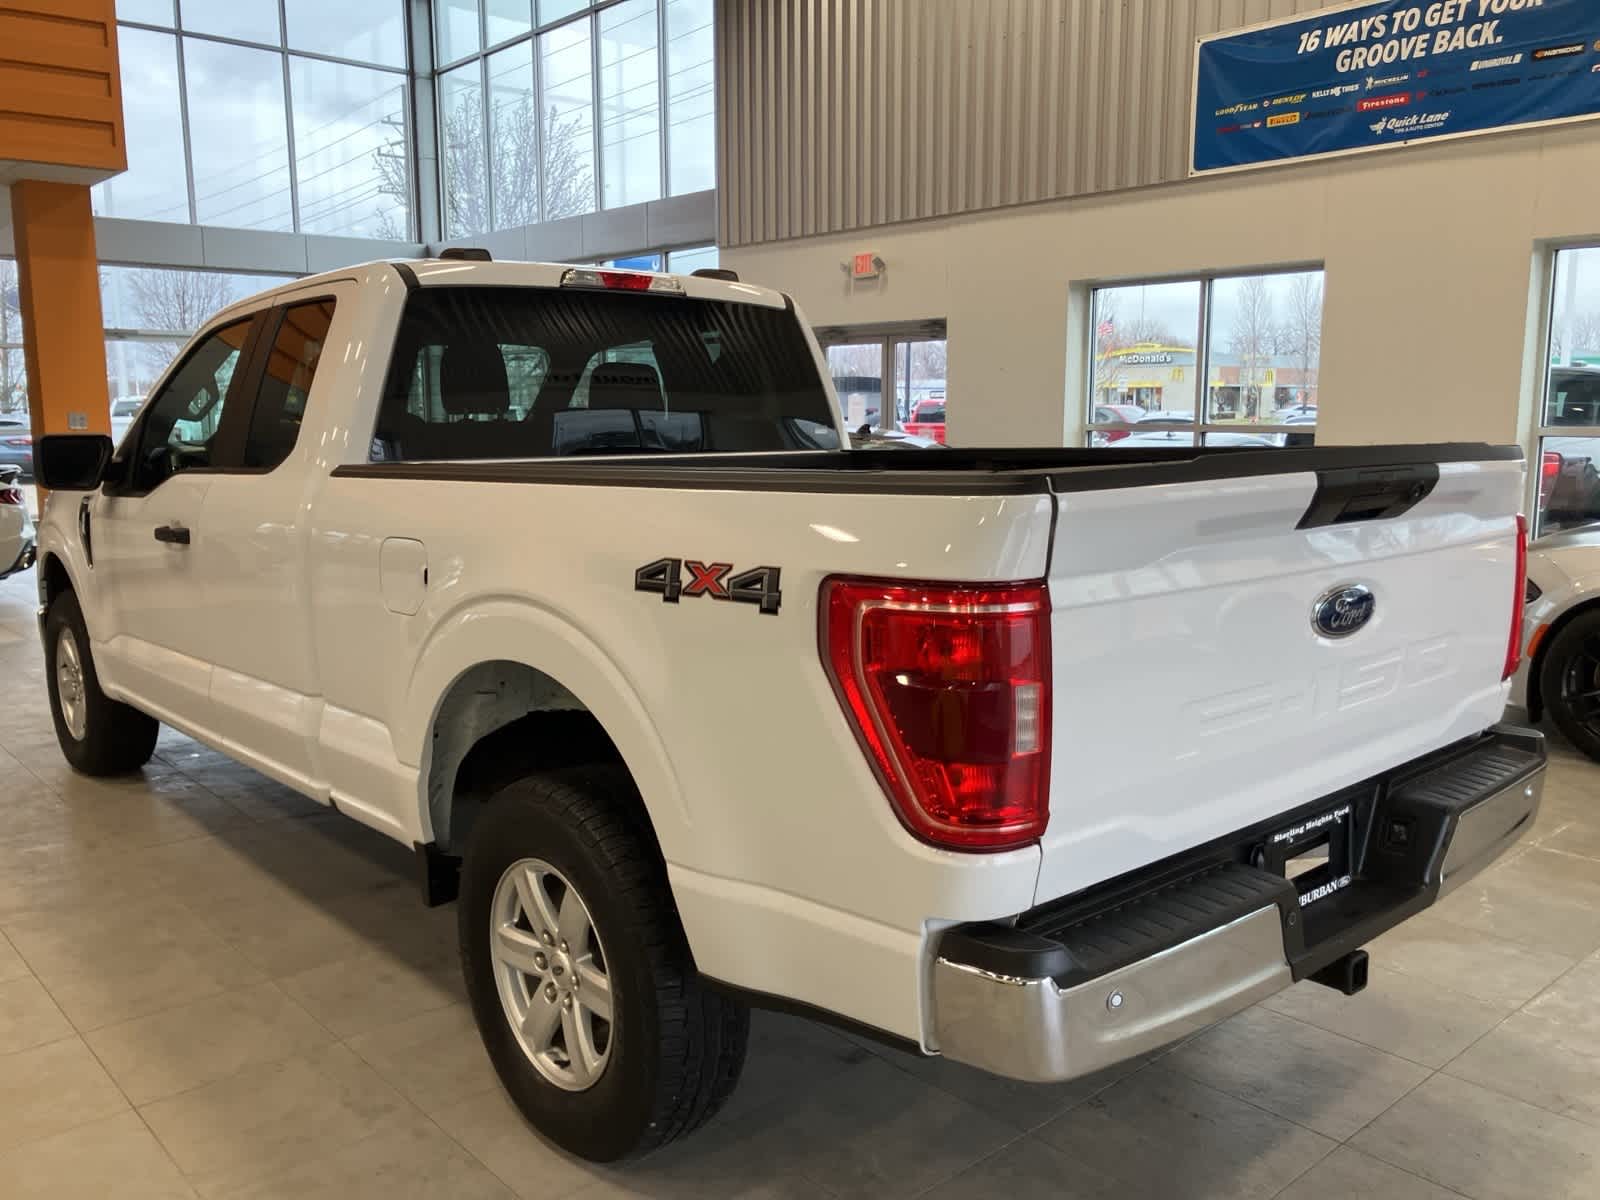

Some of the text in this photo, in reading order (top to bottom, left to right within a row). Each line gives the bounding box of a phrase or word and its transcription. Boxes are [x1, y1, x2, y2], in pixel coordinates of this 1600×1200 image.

[1298, 30, 1322, 54] 16
[1324, 15, 1387, 48] WAYS
[1392, 8, 1421, 34] TO
[1424, 0, 1470, 27] GET
[1336, 20, 1503, 73] GROOVE BACK.
[1215, 103, 1259, 117] GOODYEAR
[1362, 97, 1406, 110] Firestone
[1386, 112, 1449, 130] Quick Lane
[855, 255, 873, 273] EXIT
[1119, 352, 1172, 364] McDonald's
[1274, 805, 1349, 843] Sterling Heights Ford
[1299, 879, 1338, 907] BURBAN
